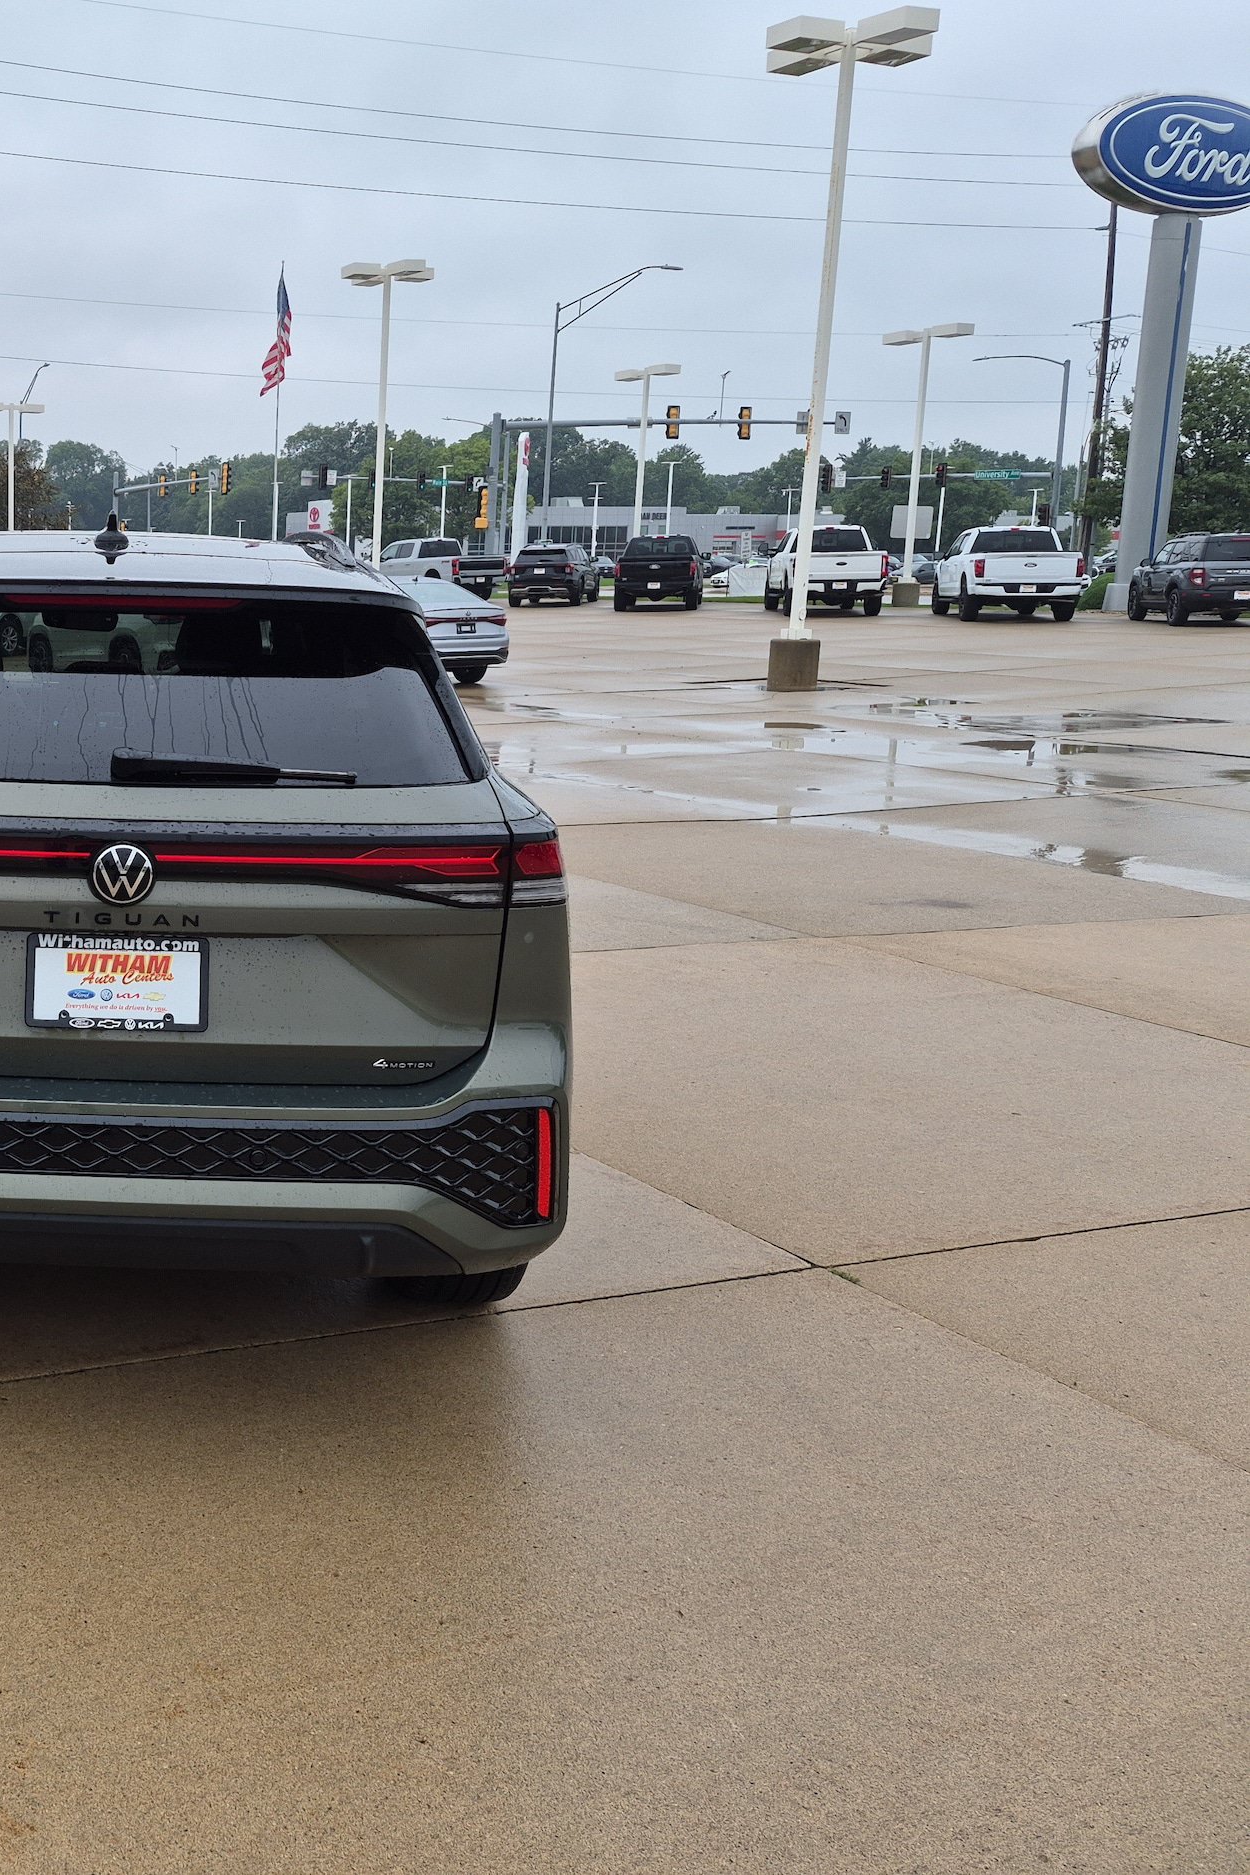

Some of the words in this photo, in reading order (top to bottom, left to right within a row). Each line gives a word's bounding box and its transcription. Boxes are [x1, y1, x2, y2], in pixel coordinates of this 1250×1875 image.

[1144, 114, 1250, 186] Ford
[975, 471, 1010, 479] University
[44, 911, 199, 927] TIGUAN
[38, 933, 199, 951] Withamauto.com
[66, 952, 172, 974] WITHAM
[80, 971, 116, 985] Auto
[122, 969, 174, 985] Centers
[373, 1058, 434, 1069] 4MOTION
